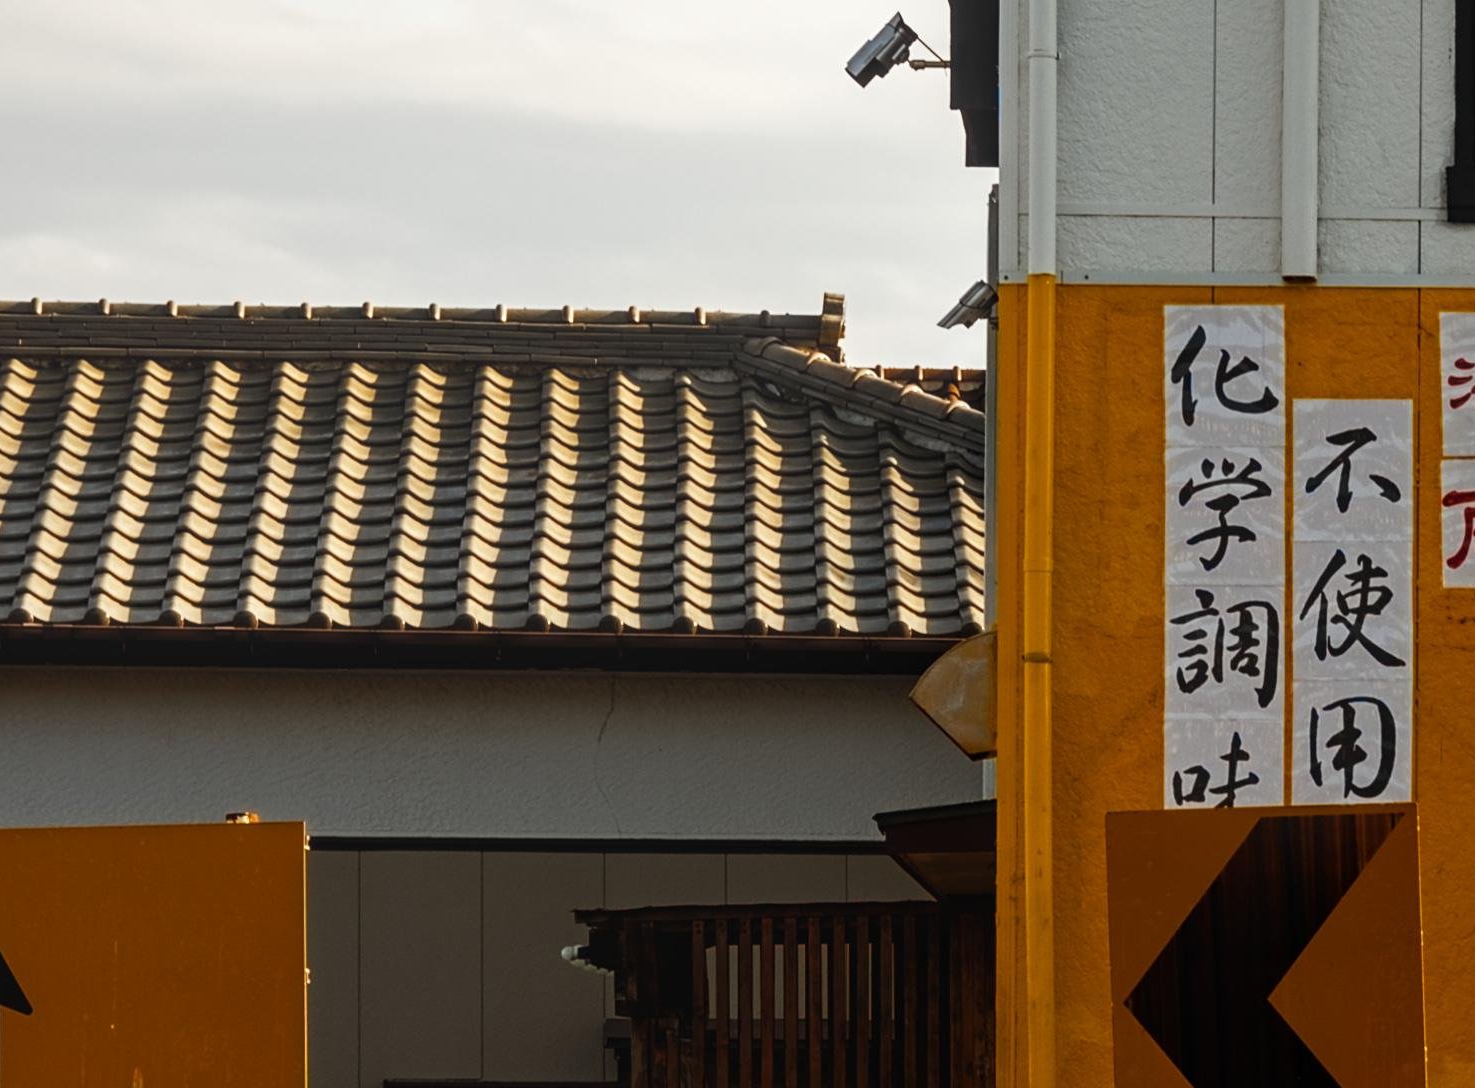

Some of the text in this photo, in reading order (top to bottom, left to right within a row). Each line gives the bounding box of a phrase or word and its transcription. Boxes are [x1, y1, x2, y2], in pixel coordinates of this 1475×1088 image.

[1170, 325, 1279, 808] 化学調味
[1300, 427, 1406, 799] 不使用
